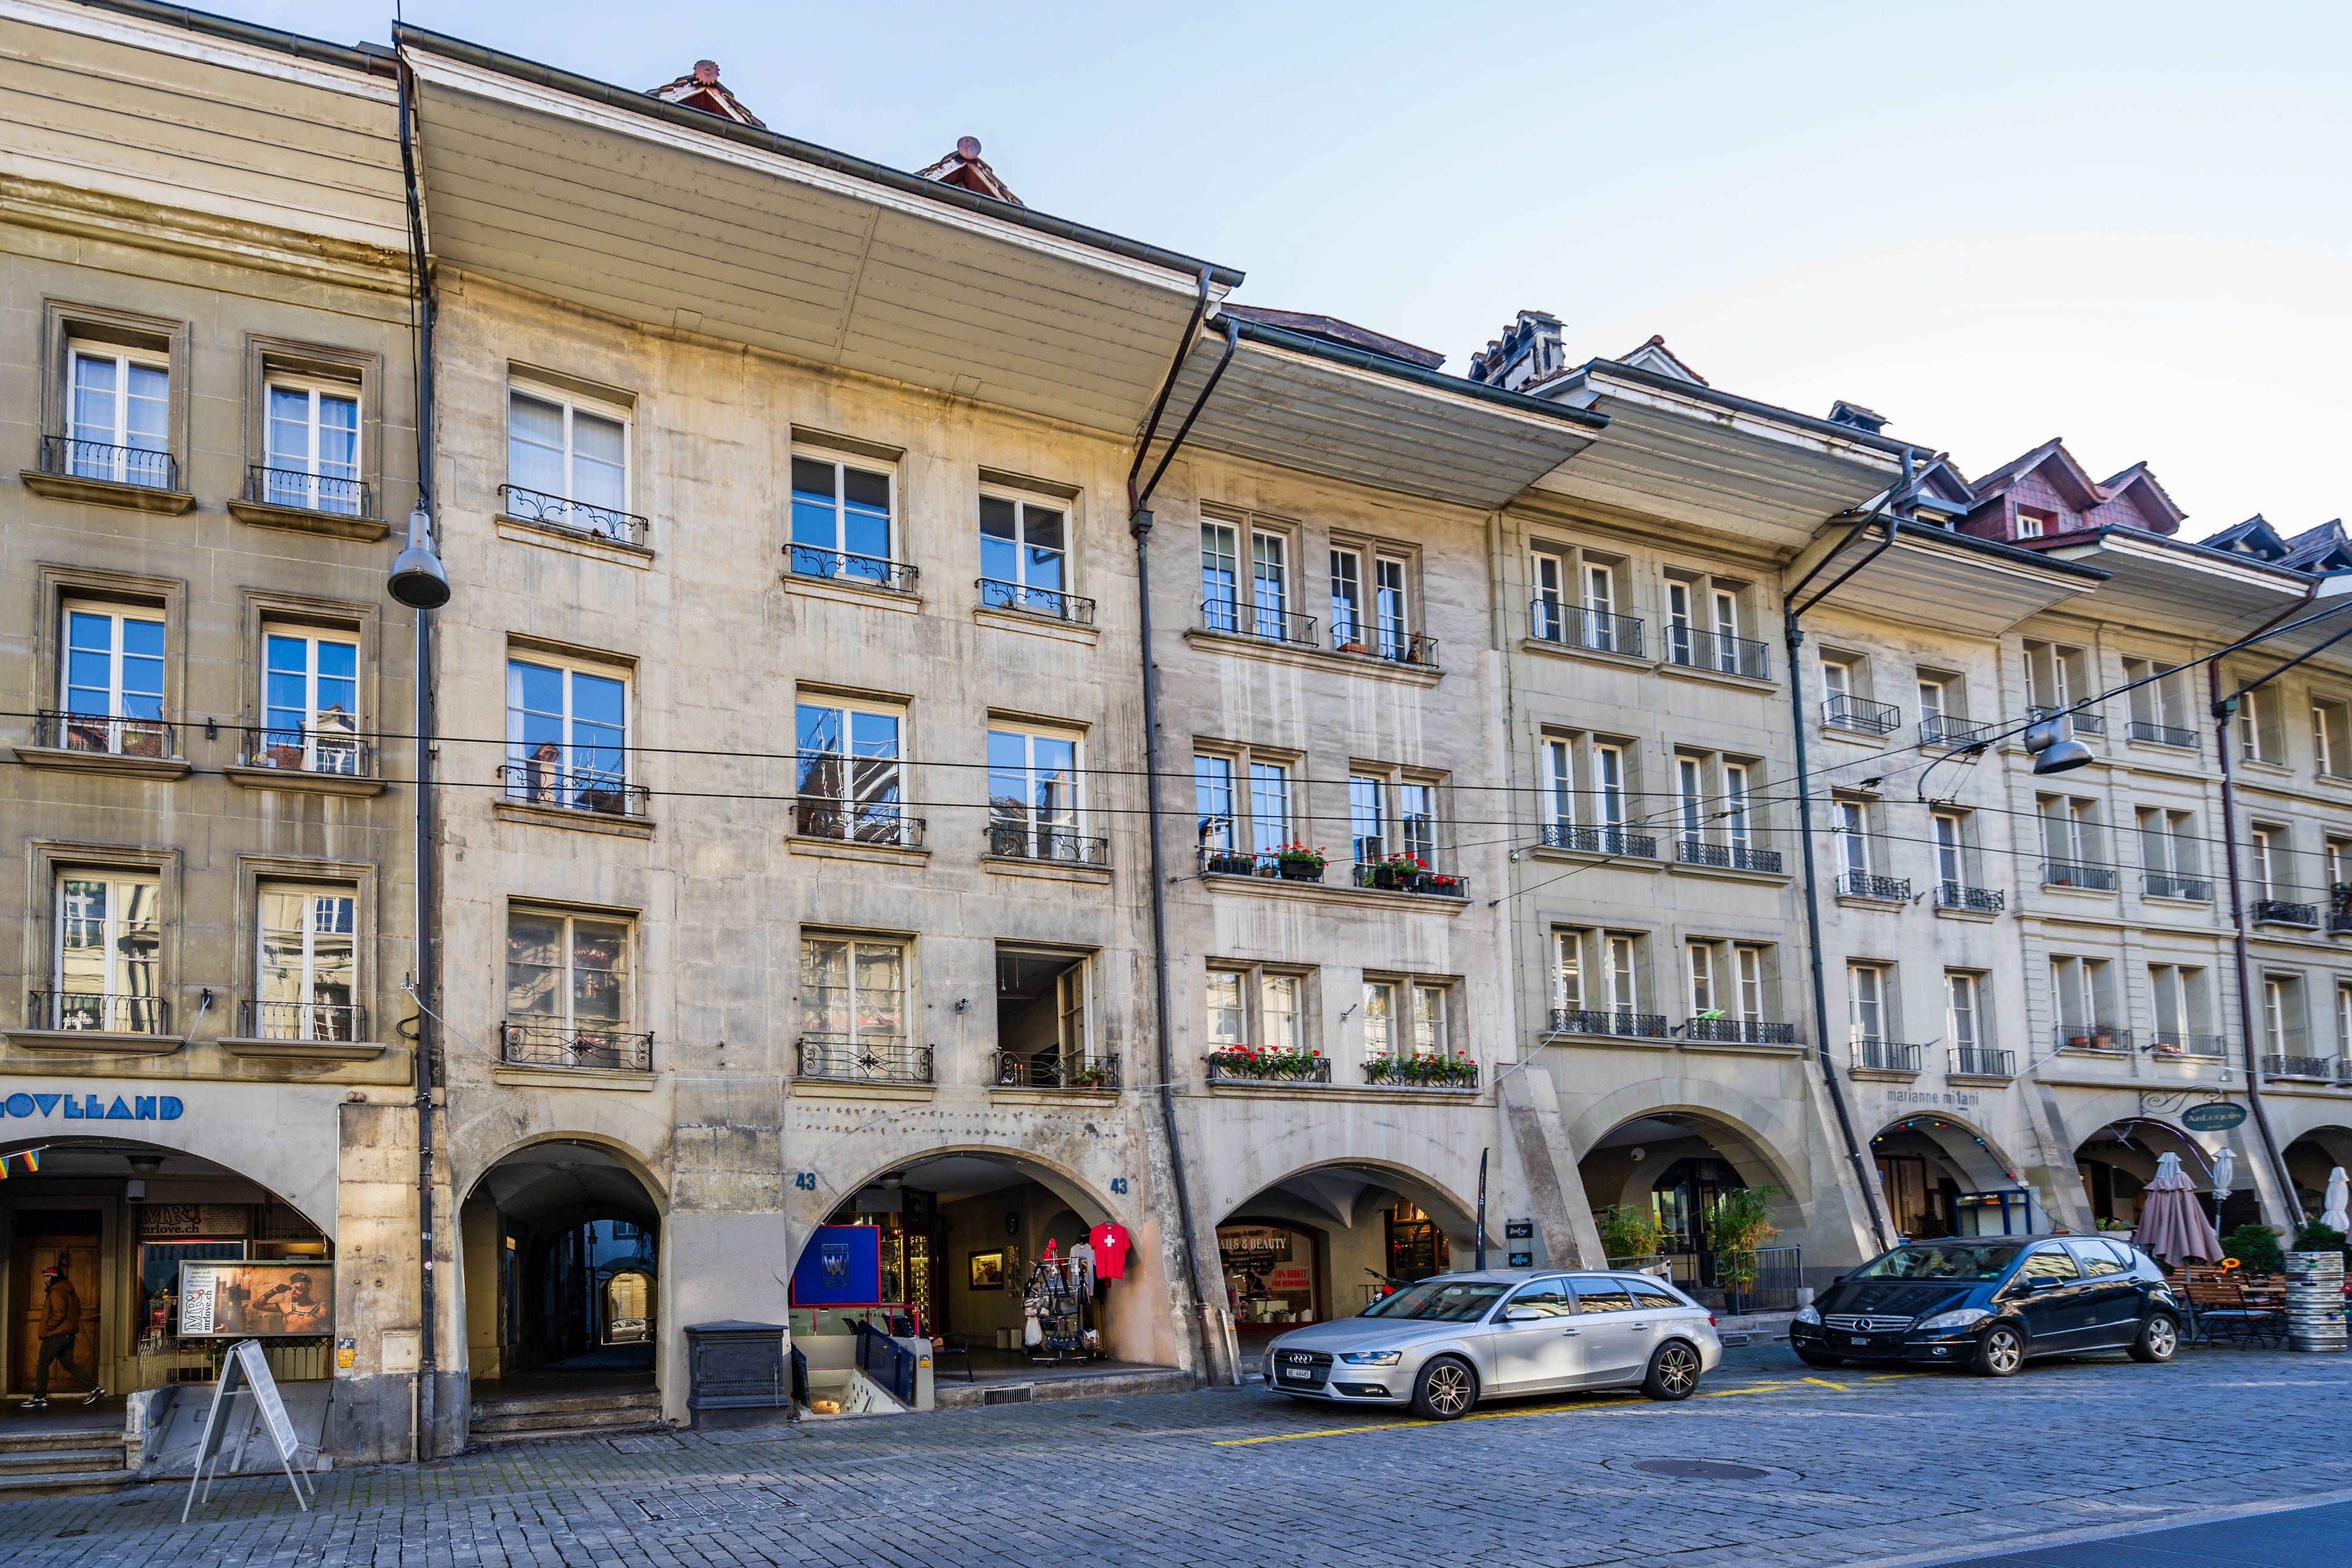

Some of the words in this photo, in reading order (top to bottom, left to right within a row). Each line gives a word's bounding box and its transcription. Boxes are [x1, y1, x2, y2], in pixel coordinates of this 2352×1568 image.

[1888, 1088, 1939, 1103] marianne
[0, 1093, 184, 1120] OVELAND
[796, 1172, 816, 1190] 43
[1110, 1178, 1128, 1194] 43
[138, 1224, 200, 1234] mrlove.ch
[1218, 1238, 1239, 1250] AILS
[1242, 1238, 1248, 1250] &
[1250, 1238, 1286, 1250] BEAUTY
[203, 1291, 212, 1330] mrlove.ch
